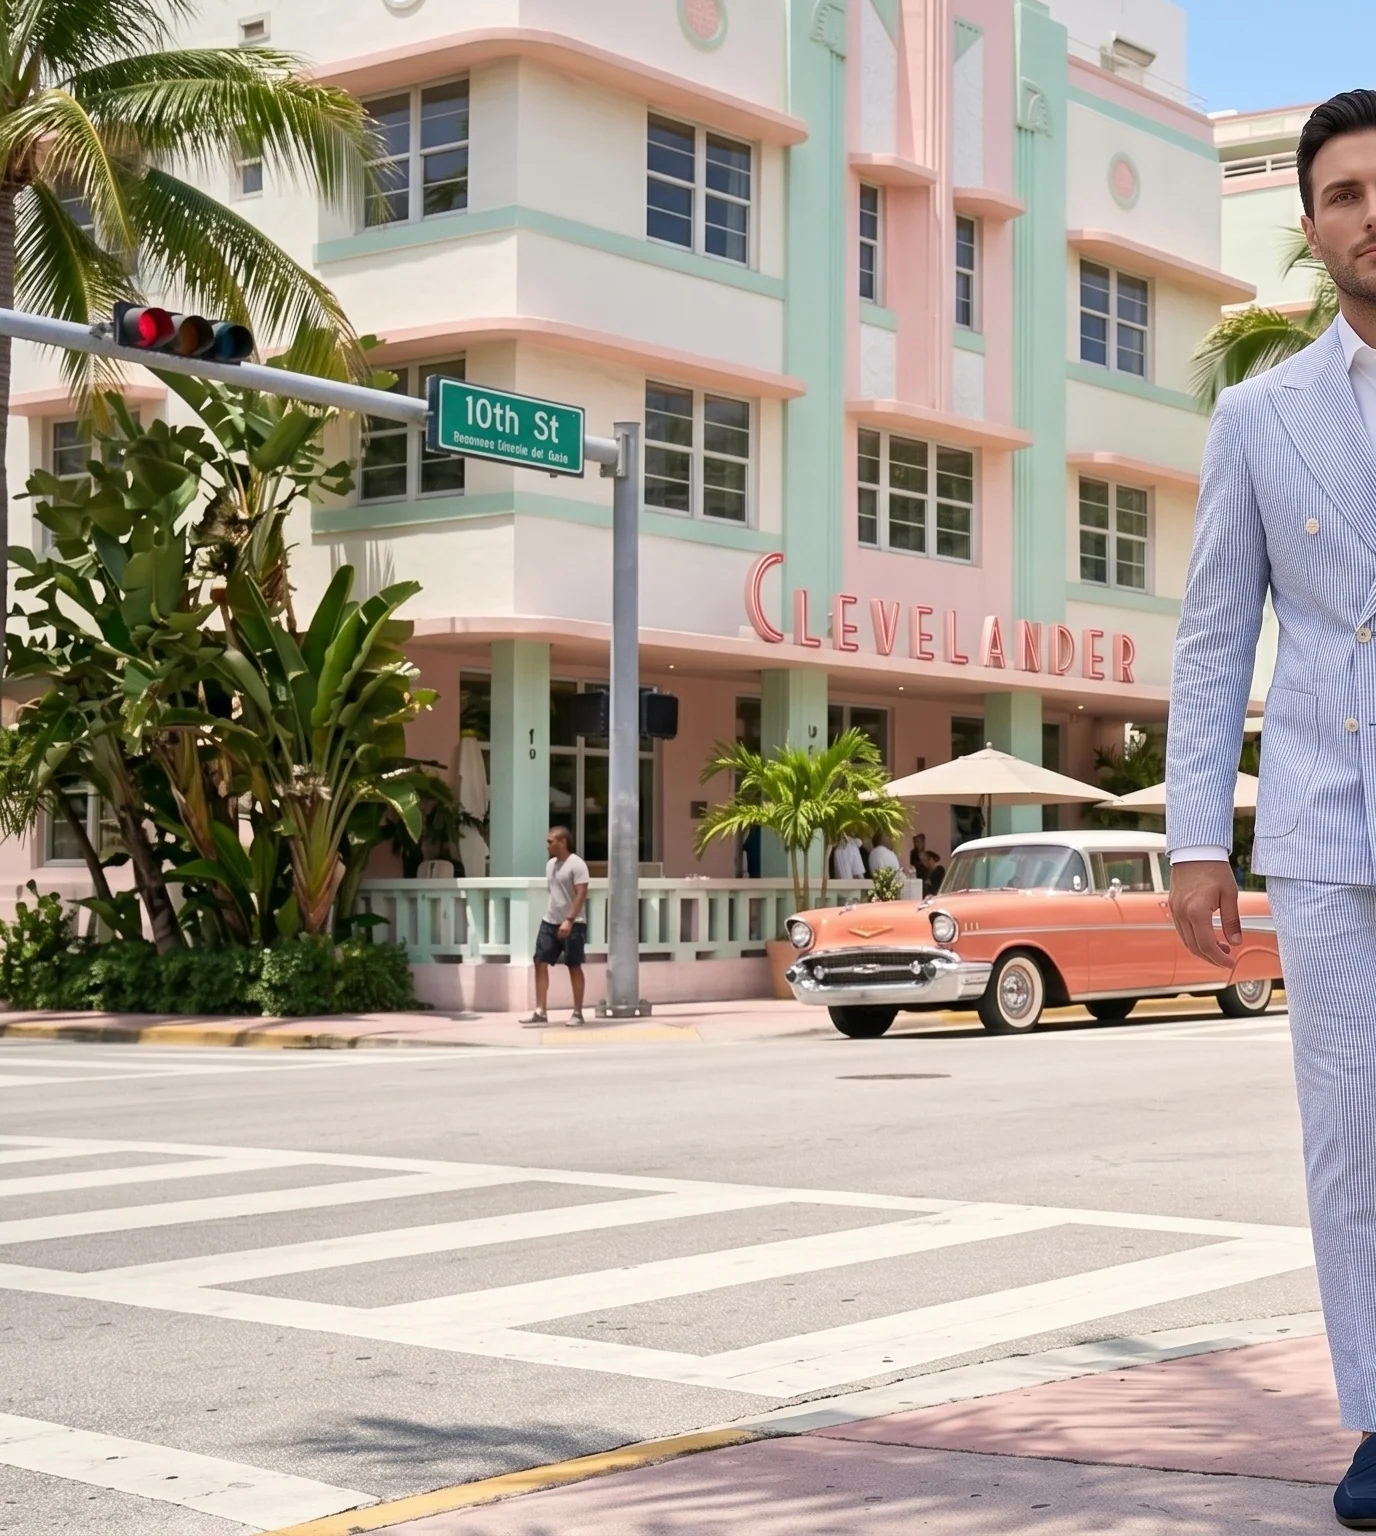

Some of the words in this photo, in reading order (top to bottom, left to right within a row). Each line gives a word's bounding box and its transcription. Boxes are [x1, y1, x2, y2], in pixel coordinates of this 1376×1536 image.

[465, 395, 519, 436] 10th
[533, 410, 560, 444] St
[744, 551, 1135, 683] CLEVELANDER
